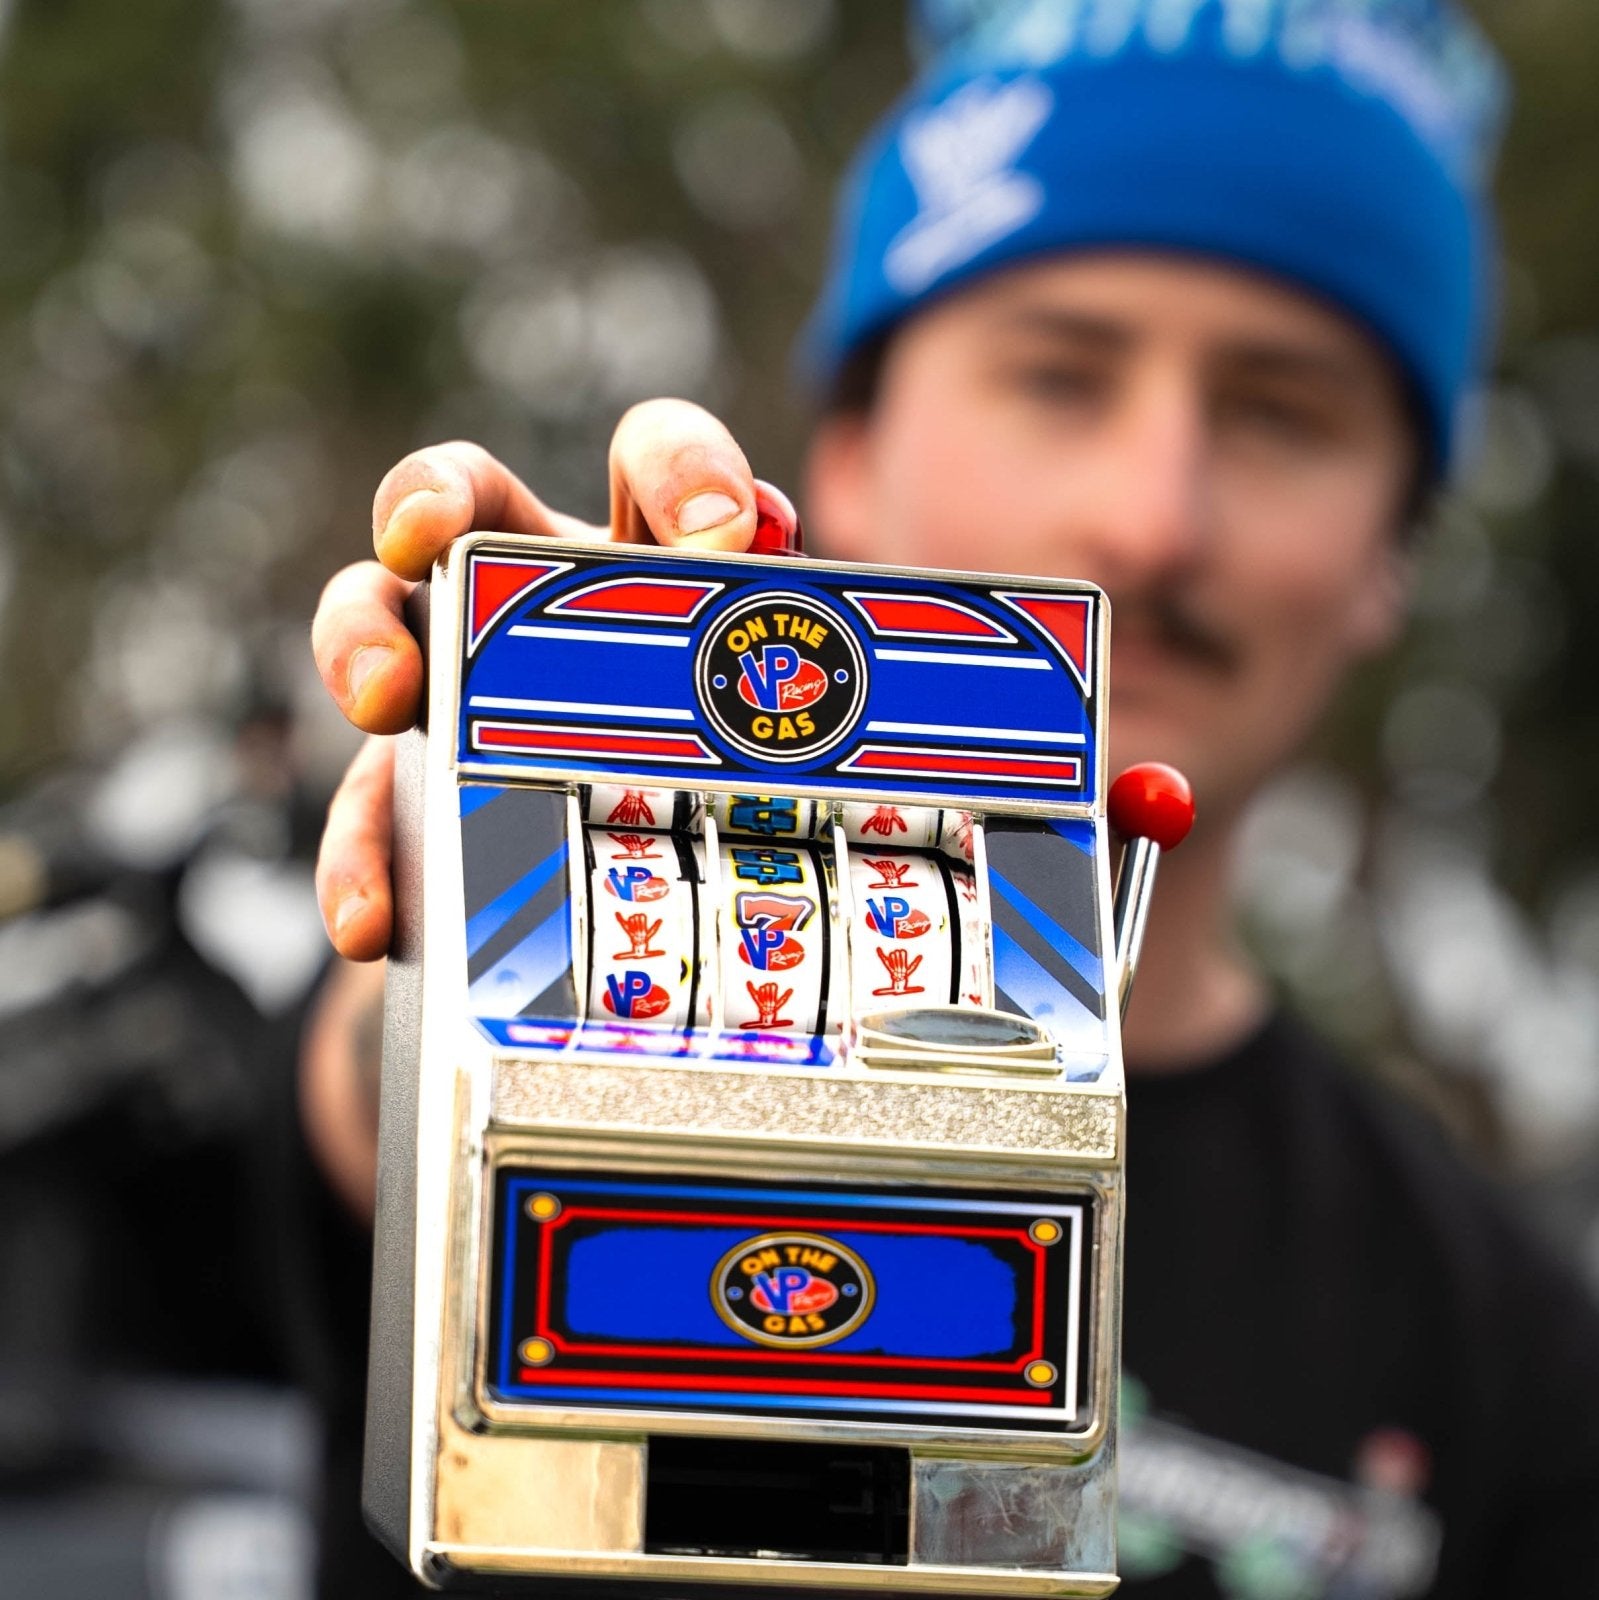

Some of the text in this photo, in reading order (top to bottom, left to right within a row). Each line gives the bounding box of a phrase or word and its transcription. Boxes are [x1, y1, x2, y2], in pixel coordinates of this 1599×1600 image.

[727, 614, 829, 653] ON THE
[738, 644, 800, 711] VP
[781, 678, 827, 704] Racing
[751, 712, 816, 740] GAS
[608, 866, 653, 902] VP
[735, 892, 816, 931] 7
[865, 896, 910, 938] VP
[740, 929, 785, 971] VP
[606, 970, 652, 1018] VP
[740, 1246, 838, 1276] ON THE
[751, 1266, 811, 1315] VP
[763, 1314, 826, 1335] GAS
